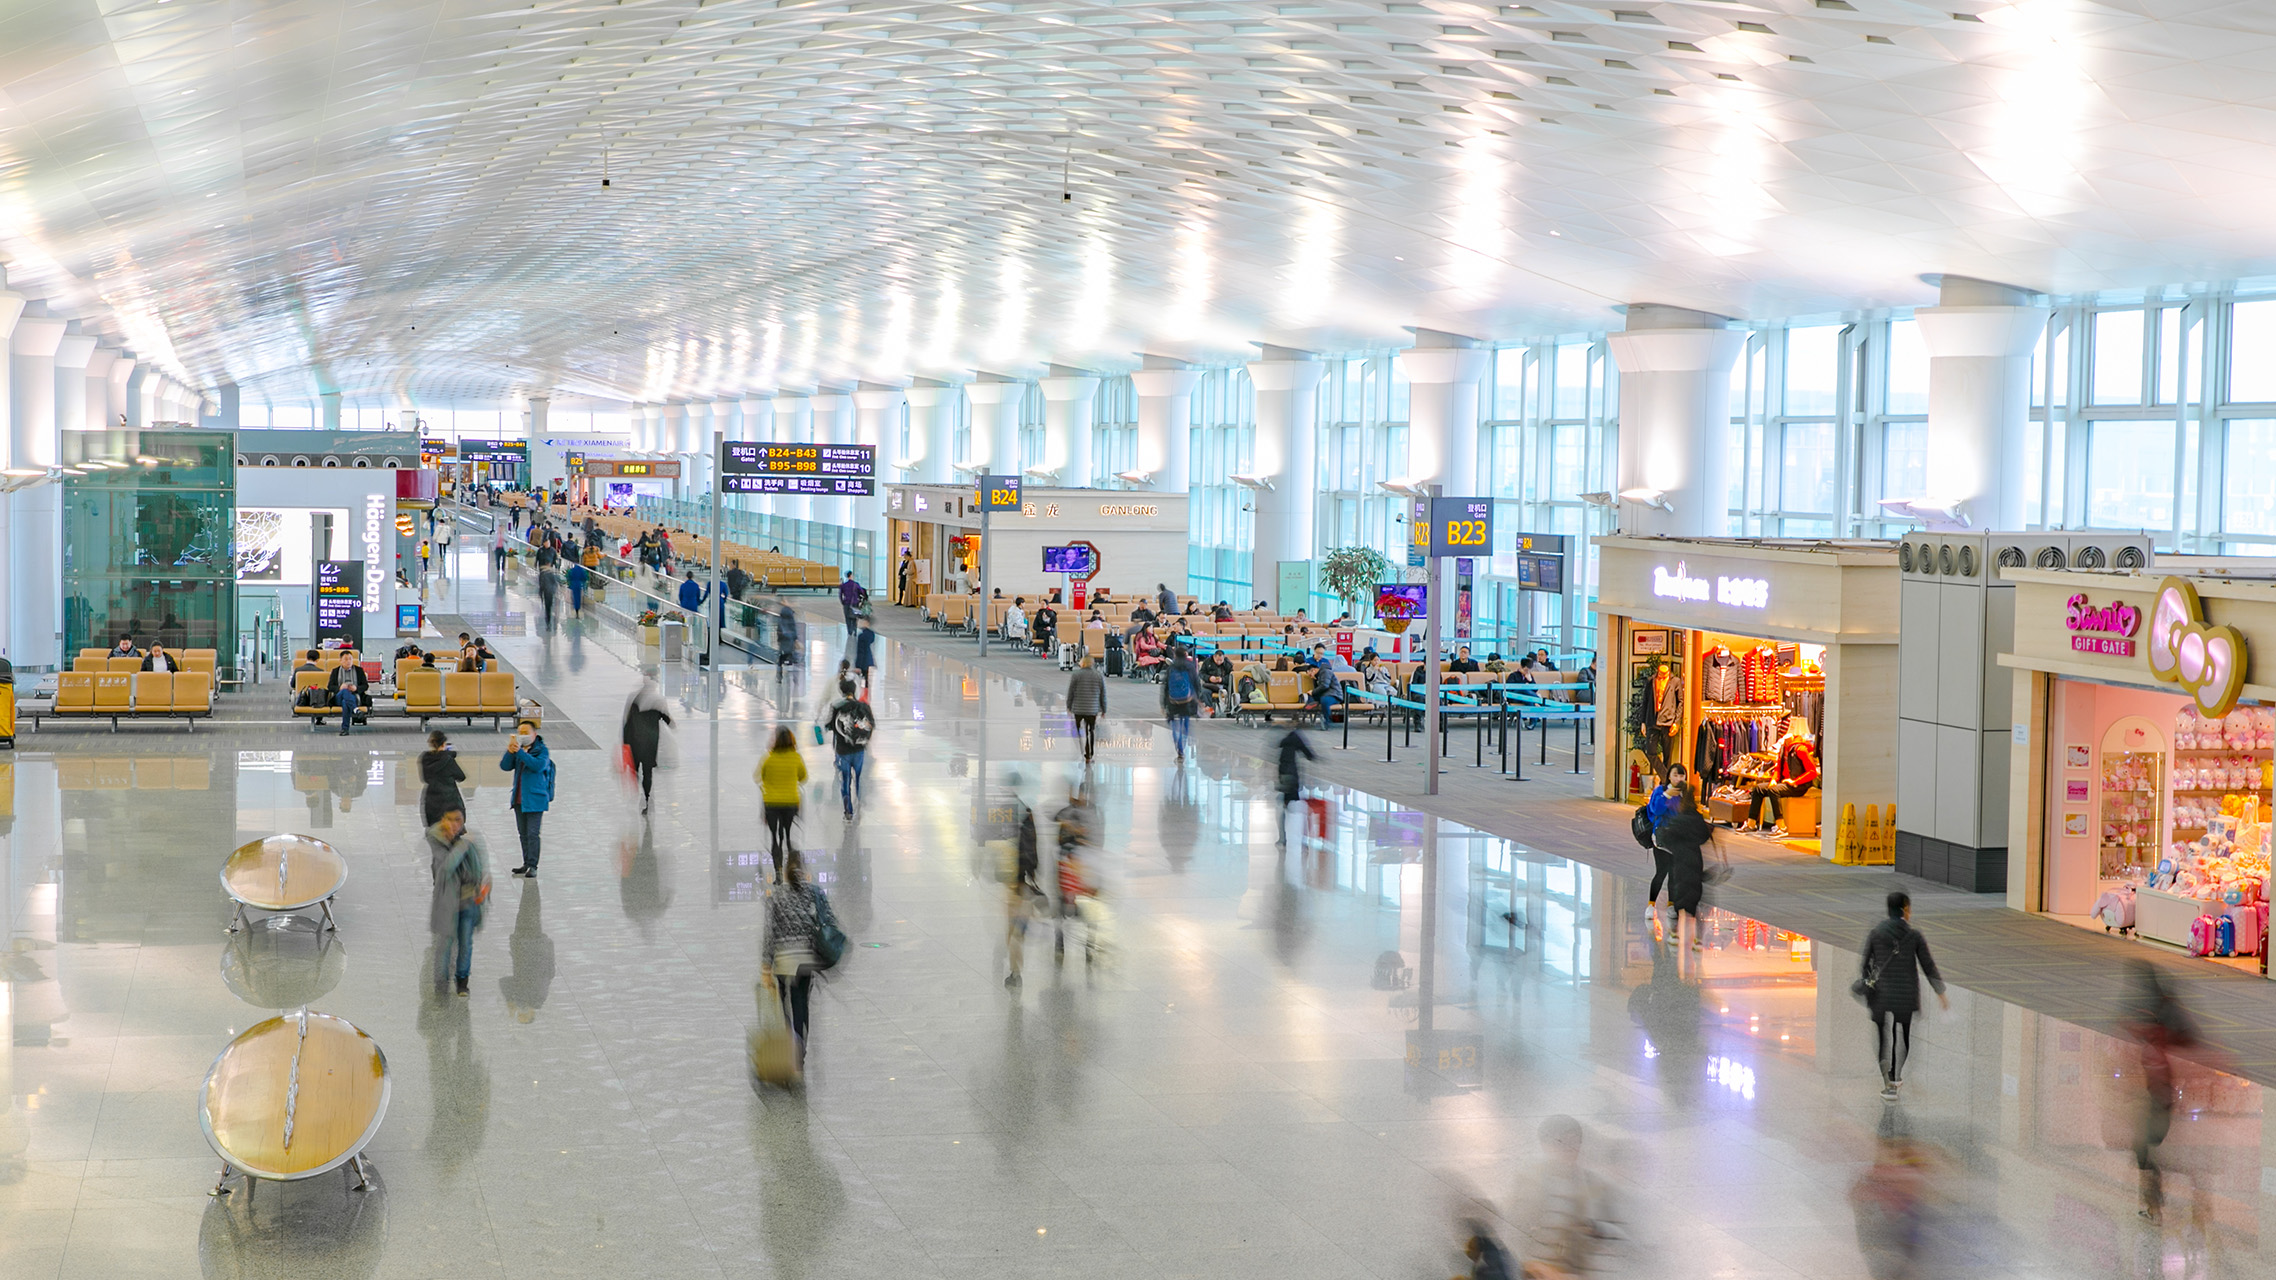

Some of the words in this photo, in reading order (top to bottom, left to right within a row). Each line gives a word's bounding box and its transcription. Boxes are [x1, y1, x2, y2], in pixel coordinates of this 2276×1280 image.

[732, 447, 755, 456] 登机口
[769, 448, 817, 458] B24-B43
[860, 450, 870, 459] 11
[770, 461, 817, 471] B95-B98
[860, 464, 871, 473] 10
[991, 489, 1018, 505] B24
[1100, 504, 1158, 516] GANLONG
[1467, 504, 1487, 512] 登机口
[1415, 522, 1429, 546] B23
[1447, 520, 1486, 545] B23
[2075, 637, 2096, 651] GIFT
[2102, 640, 2126, 654] GATE
